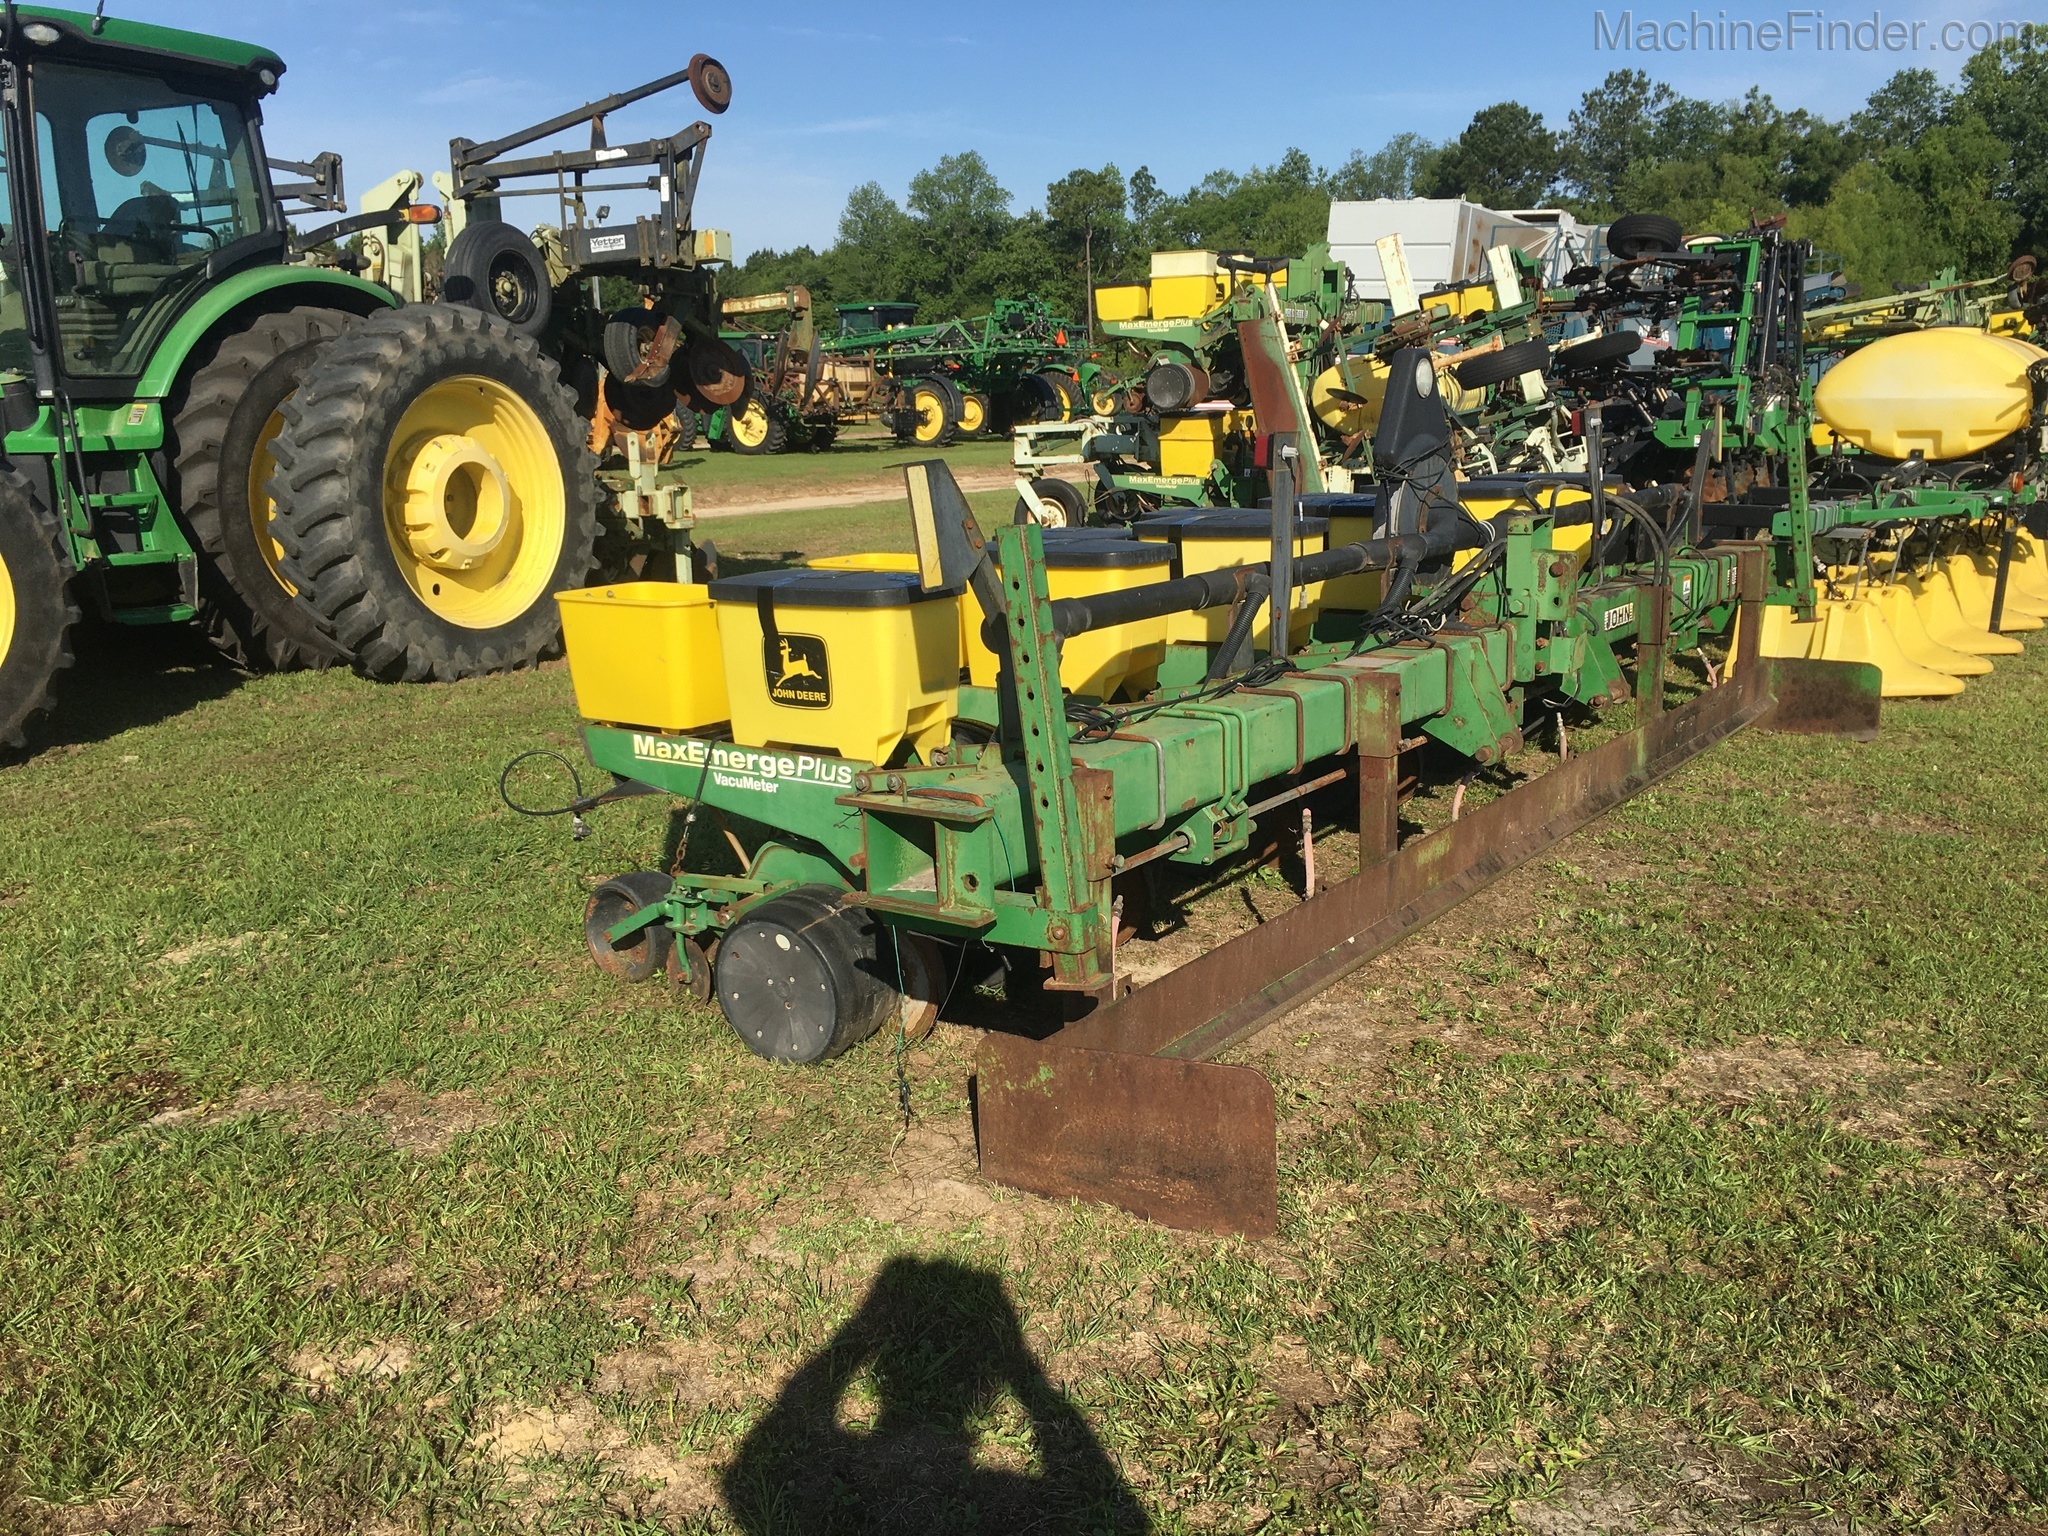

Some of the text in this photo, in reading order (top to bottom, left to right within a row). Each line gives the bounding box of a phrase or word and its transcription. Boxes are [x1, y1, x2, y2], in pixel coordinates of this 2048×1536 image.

[591, 237, 624, 247] Yetter
[1606, 605, 1631, 629] JOHN
[772, 688, 827, 702] JOHN DEERE
[712, 771, 779, 794] VacuMeter
